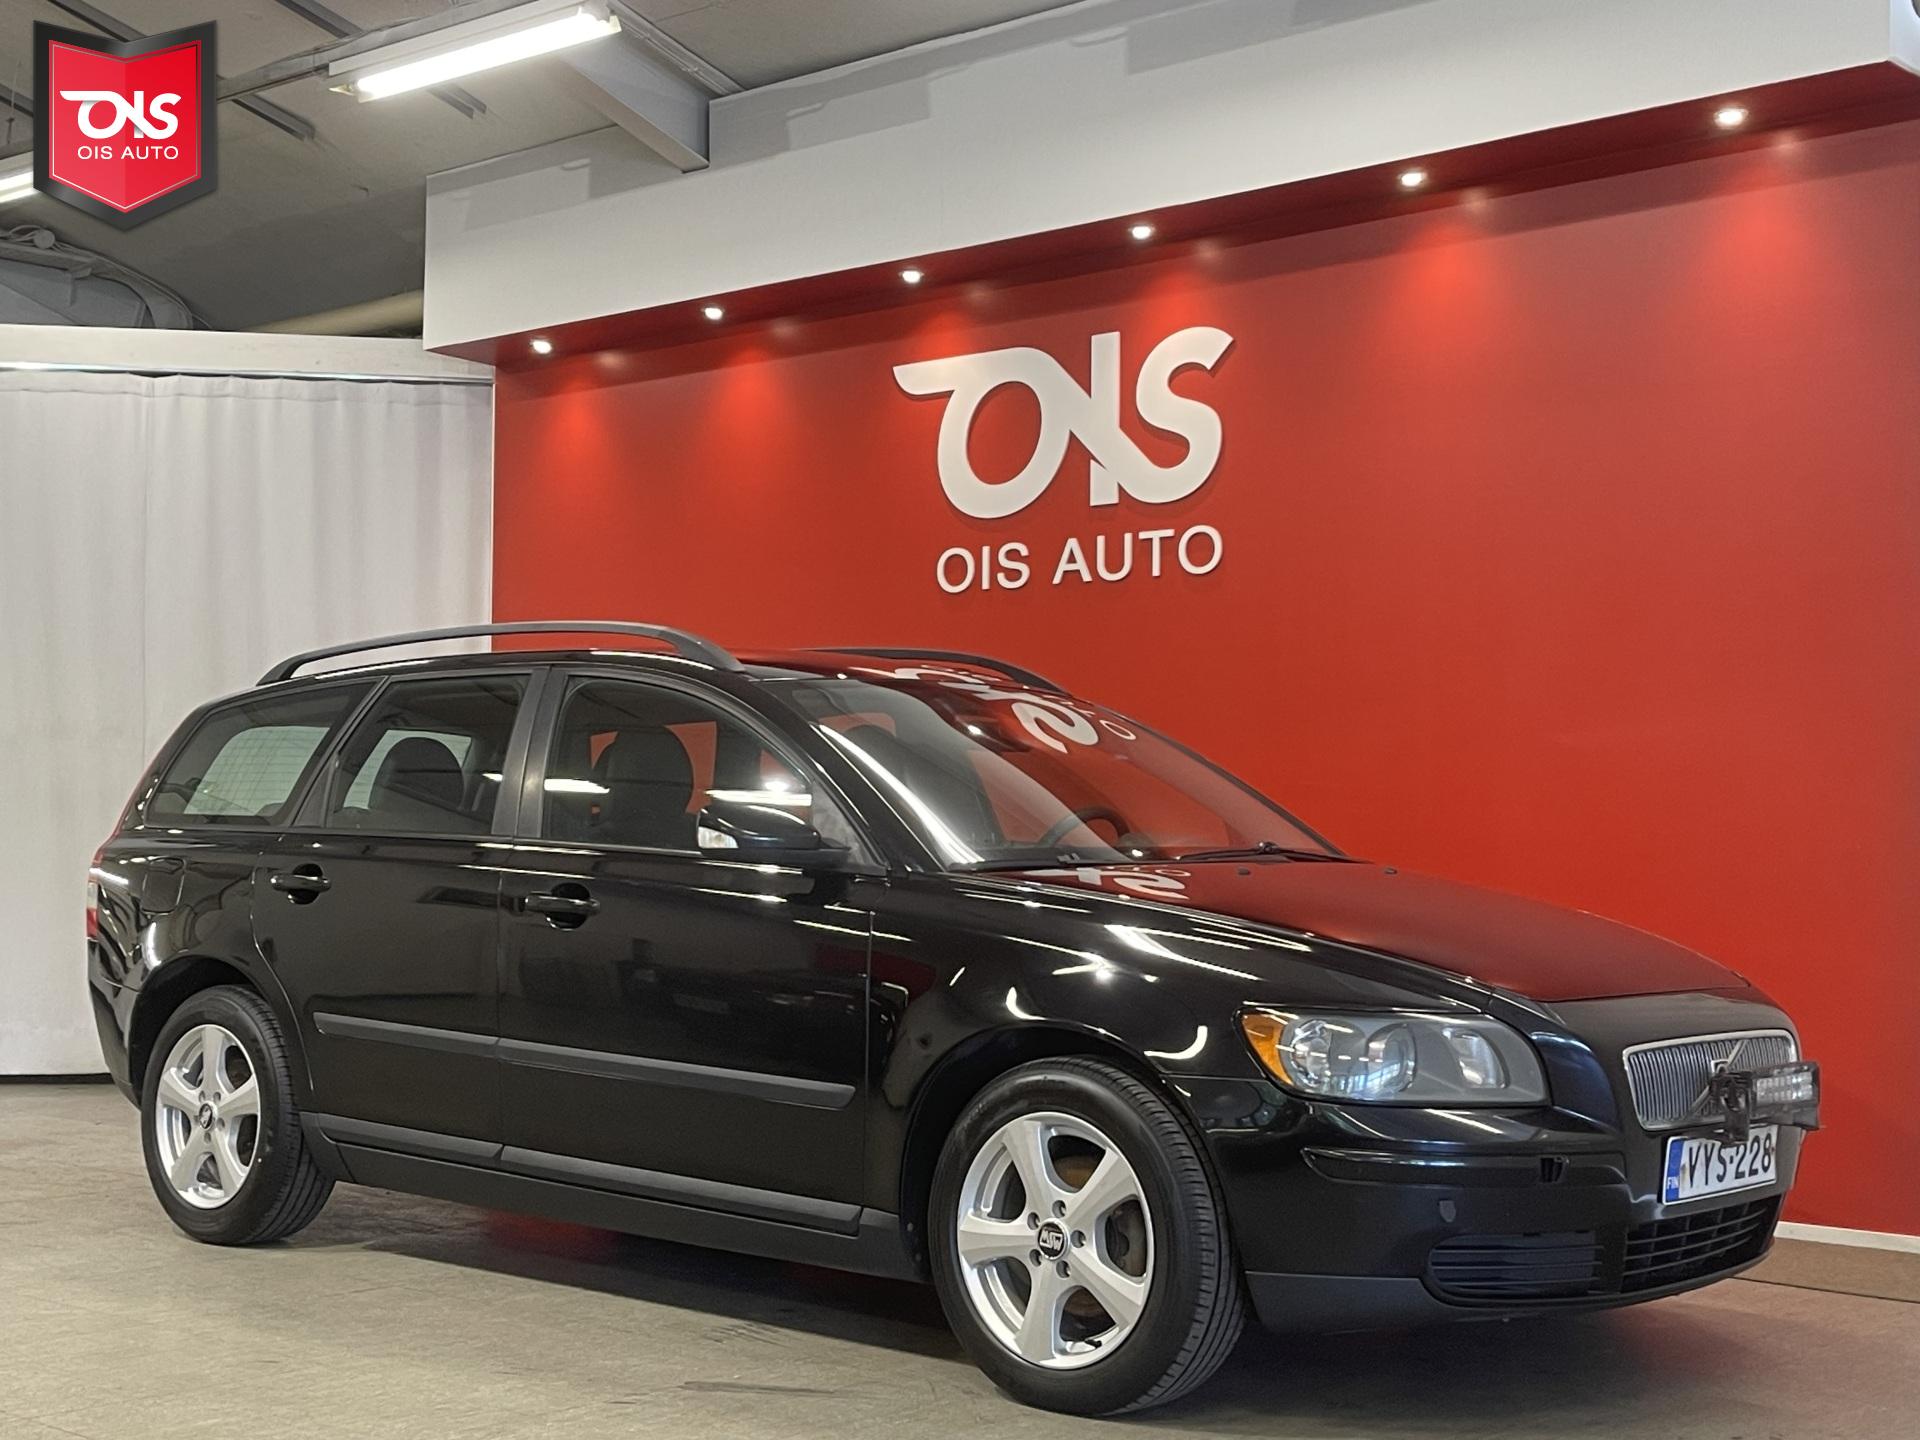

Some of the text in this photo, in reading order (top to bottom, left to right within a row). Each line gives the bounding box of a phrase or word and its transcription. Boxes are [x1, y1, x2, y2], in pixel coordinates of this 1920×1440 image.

[937, 525, 1223, 593] OIS AUTO
[1688, 1132, 1772, 1189] VYS-228
